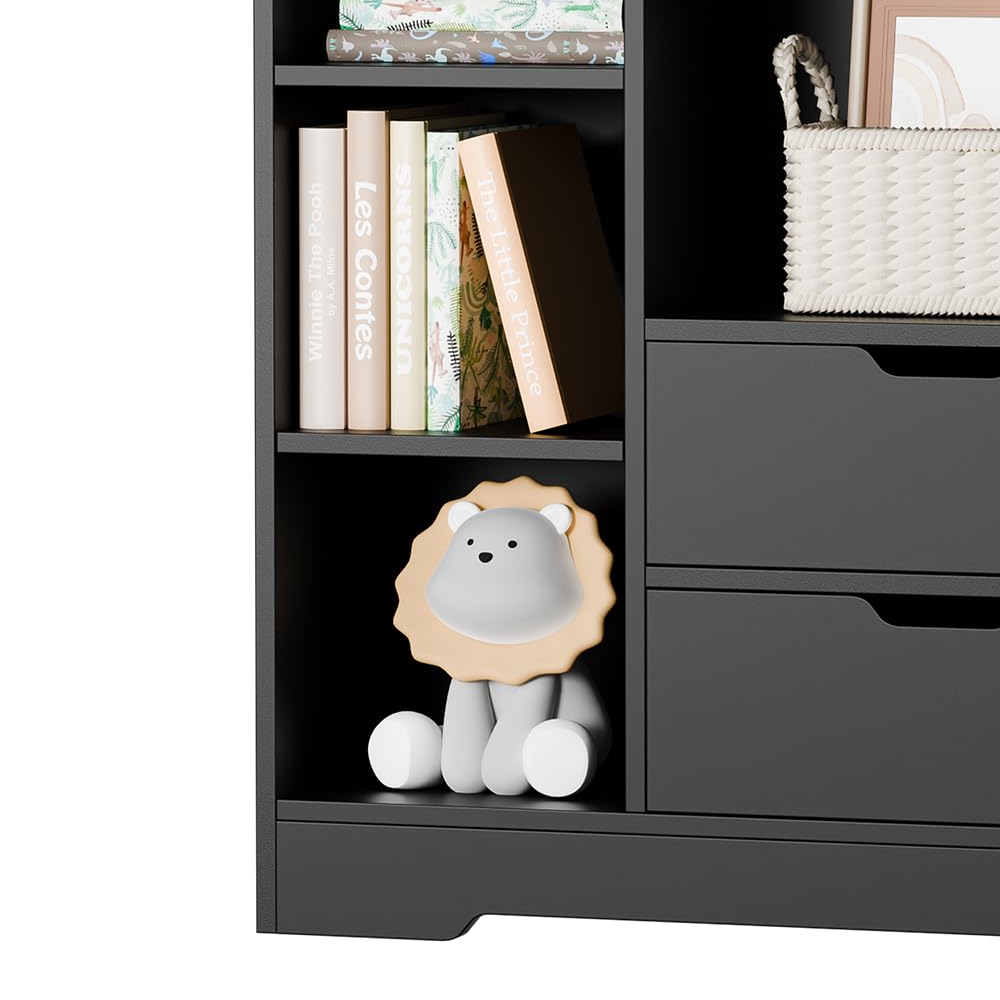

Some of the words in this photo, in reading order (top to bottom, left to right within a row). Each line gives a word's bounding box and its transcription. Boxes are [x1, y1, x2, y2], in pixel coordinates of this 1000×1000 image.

[308, 183, 322, 237] Pooh
[354, 181, 377, 237] Les
[308, 245, 322, 283] The
[396, 162, 414, 376] UNICORNS
[477, 170, 499, 223] The
[492, 231, 521, 304] Little
[511, 310, 543, 397] Prince
[308, 288, 322, 361] Winnie
[354, 248, 378, 361] Contes
